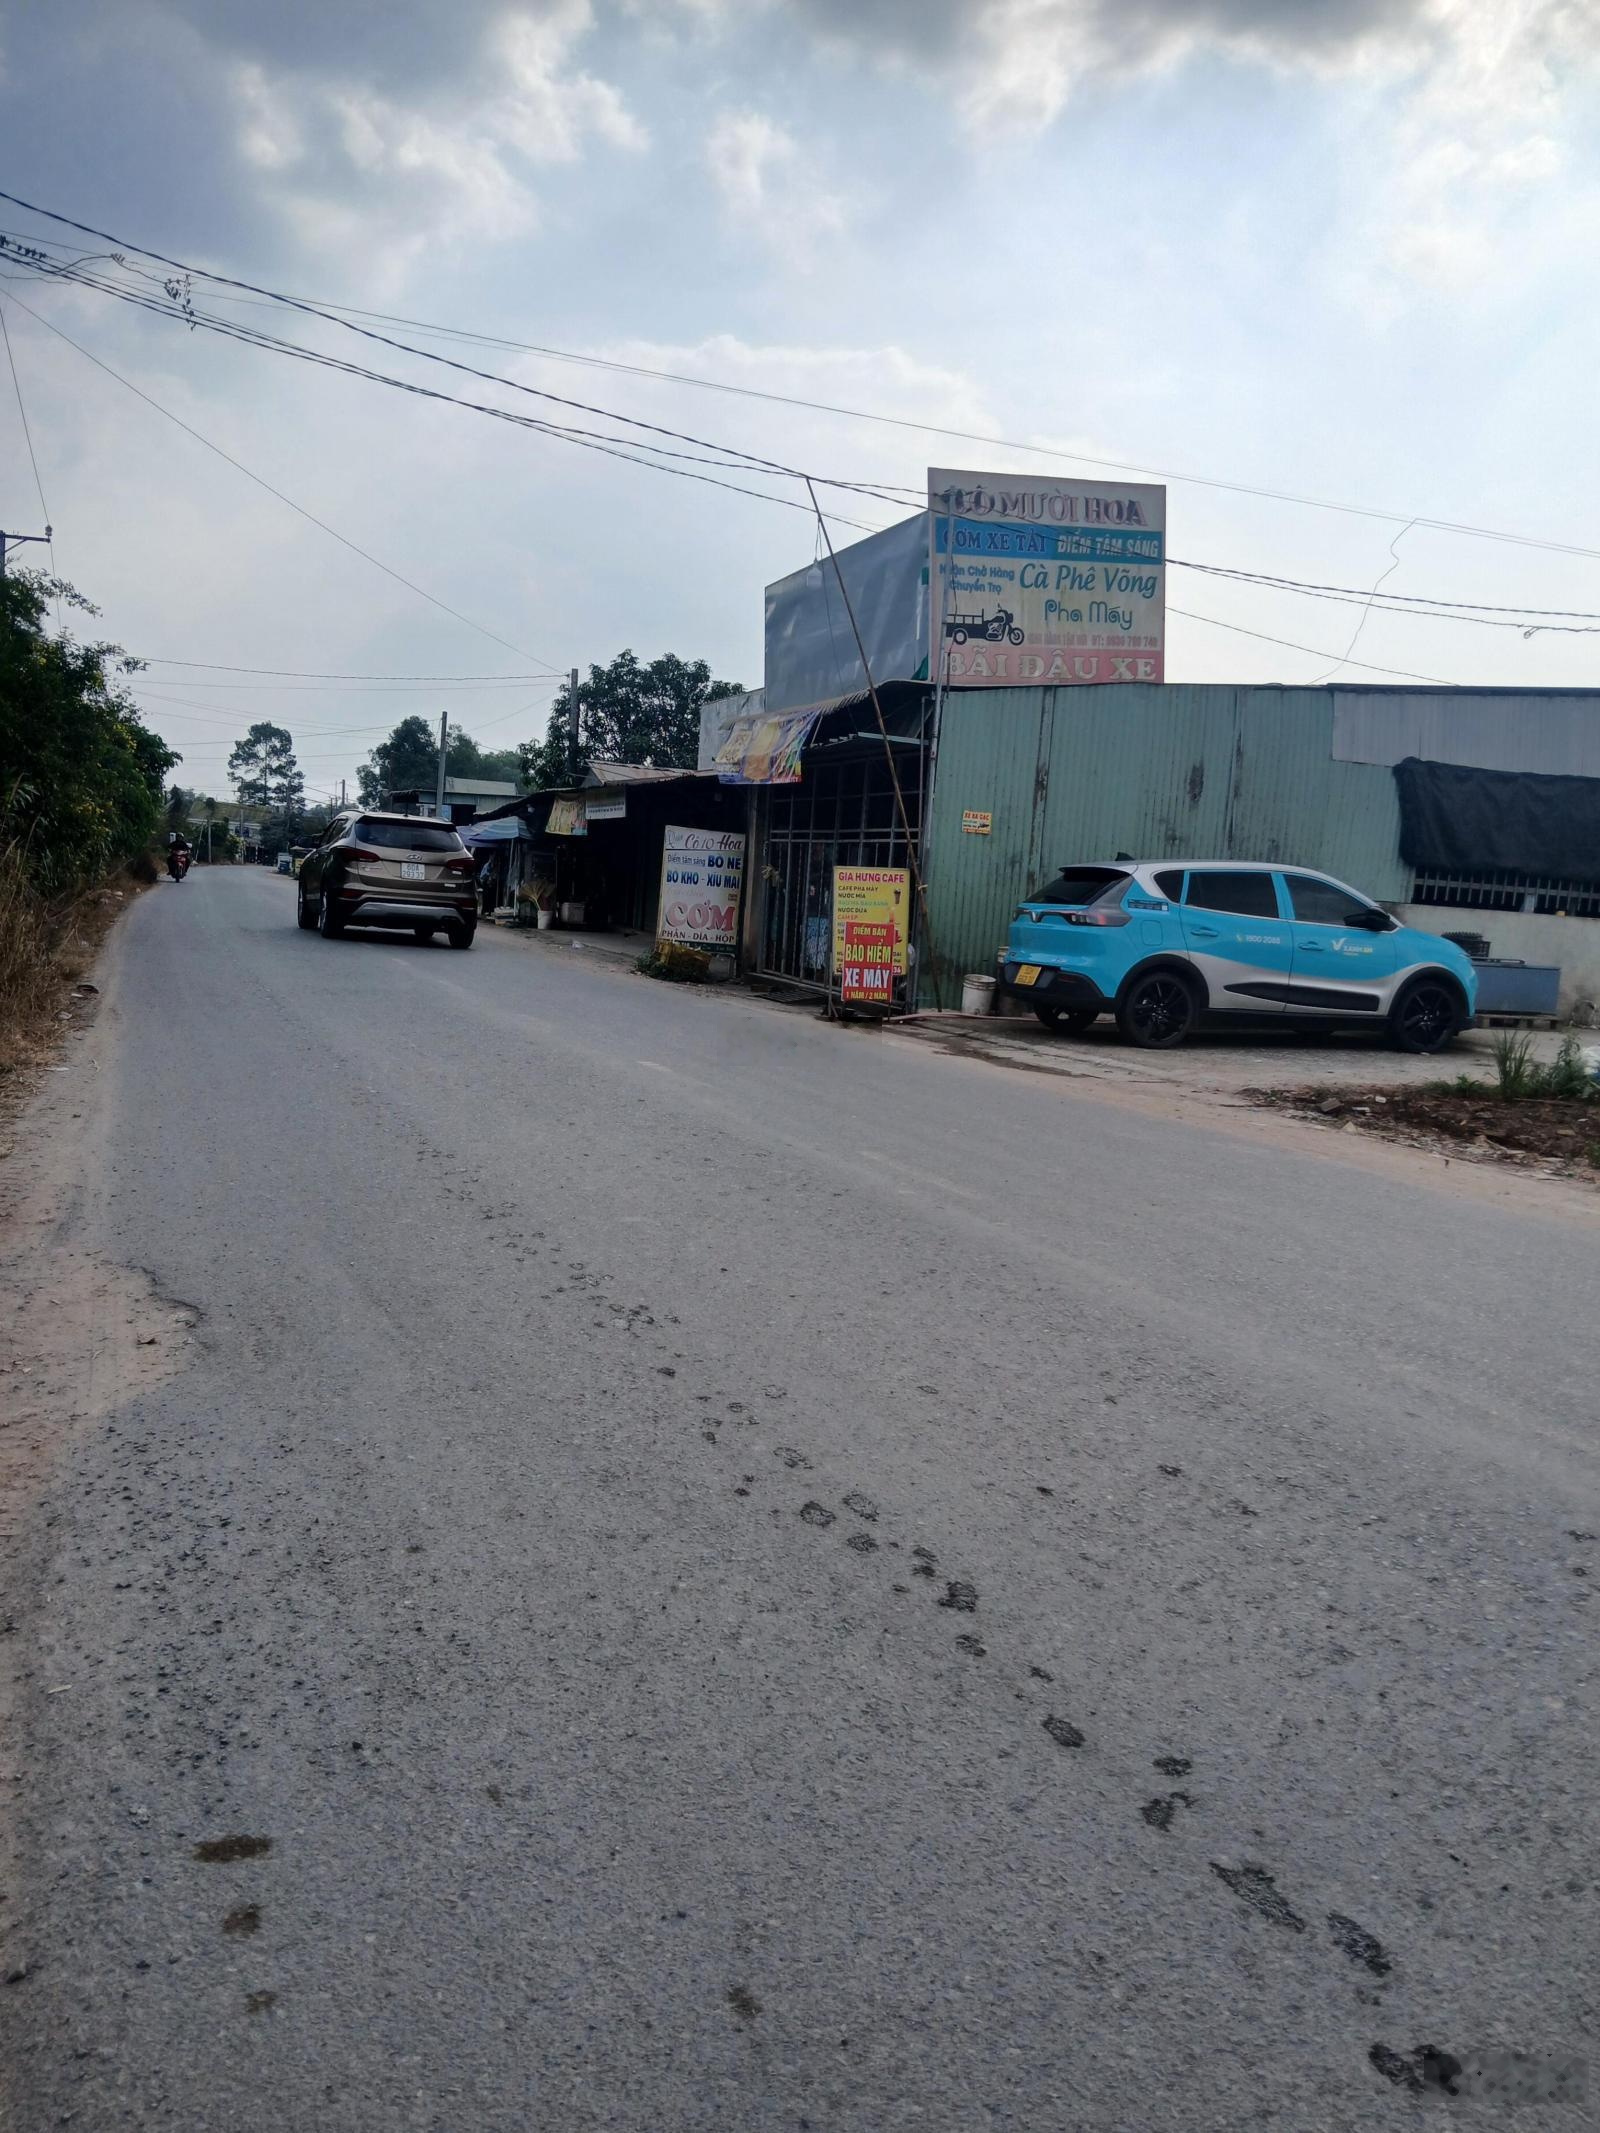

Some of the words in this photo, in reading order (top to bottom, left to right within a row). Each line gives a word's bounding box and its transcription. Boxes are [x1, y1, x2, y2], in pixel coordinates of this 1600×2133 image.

[998, 488, 1080, 523] MƯỜI
[1084, 496, 1148, 527] HOA
[987, 531, 1010, 551] XE
[1057, 528, 1092, 555] ĐIỂM
[1096, 533, 1123, 557] TÂM
[1127, 535, 1159, 558] SÁNG
[989, 567, 1015, 581] Hàng
[1020, 563, 1049, 590] Cà
[1056, 565, 1097, 591] Phê
[1103, 567, 1158, 599] Võng
[1045, 599, 1082, 624] Pha
[1089, 601, 1133, 630] Máy
[942, 645, 1008, 678] BÃI
[1019, 648, 1099, 683] ĐẬU
[1110, 657, 1156, 680] XE
[685, 833, 699, 849] Cô
[717, 834, 743, 850] Hoa
[681, 871, 699, 885] KHO
[838, 871, 854, 881] GIA
[855, 872, 881, 883] HƯNG
[882, 873, 905, 883] CAFE
[665, 899, 736, 932] CƠM
[872, 926, 887, 937] BÁN
[845, 938, 865, 962] BẢO
[867, 938, 892, 964] HIỂM
[844, 967, 860, 988] XE
[862, 965, 890, 989] MÁY
